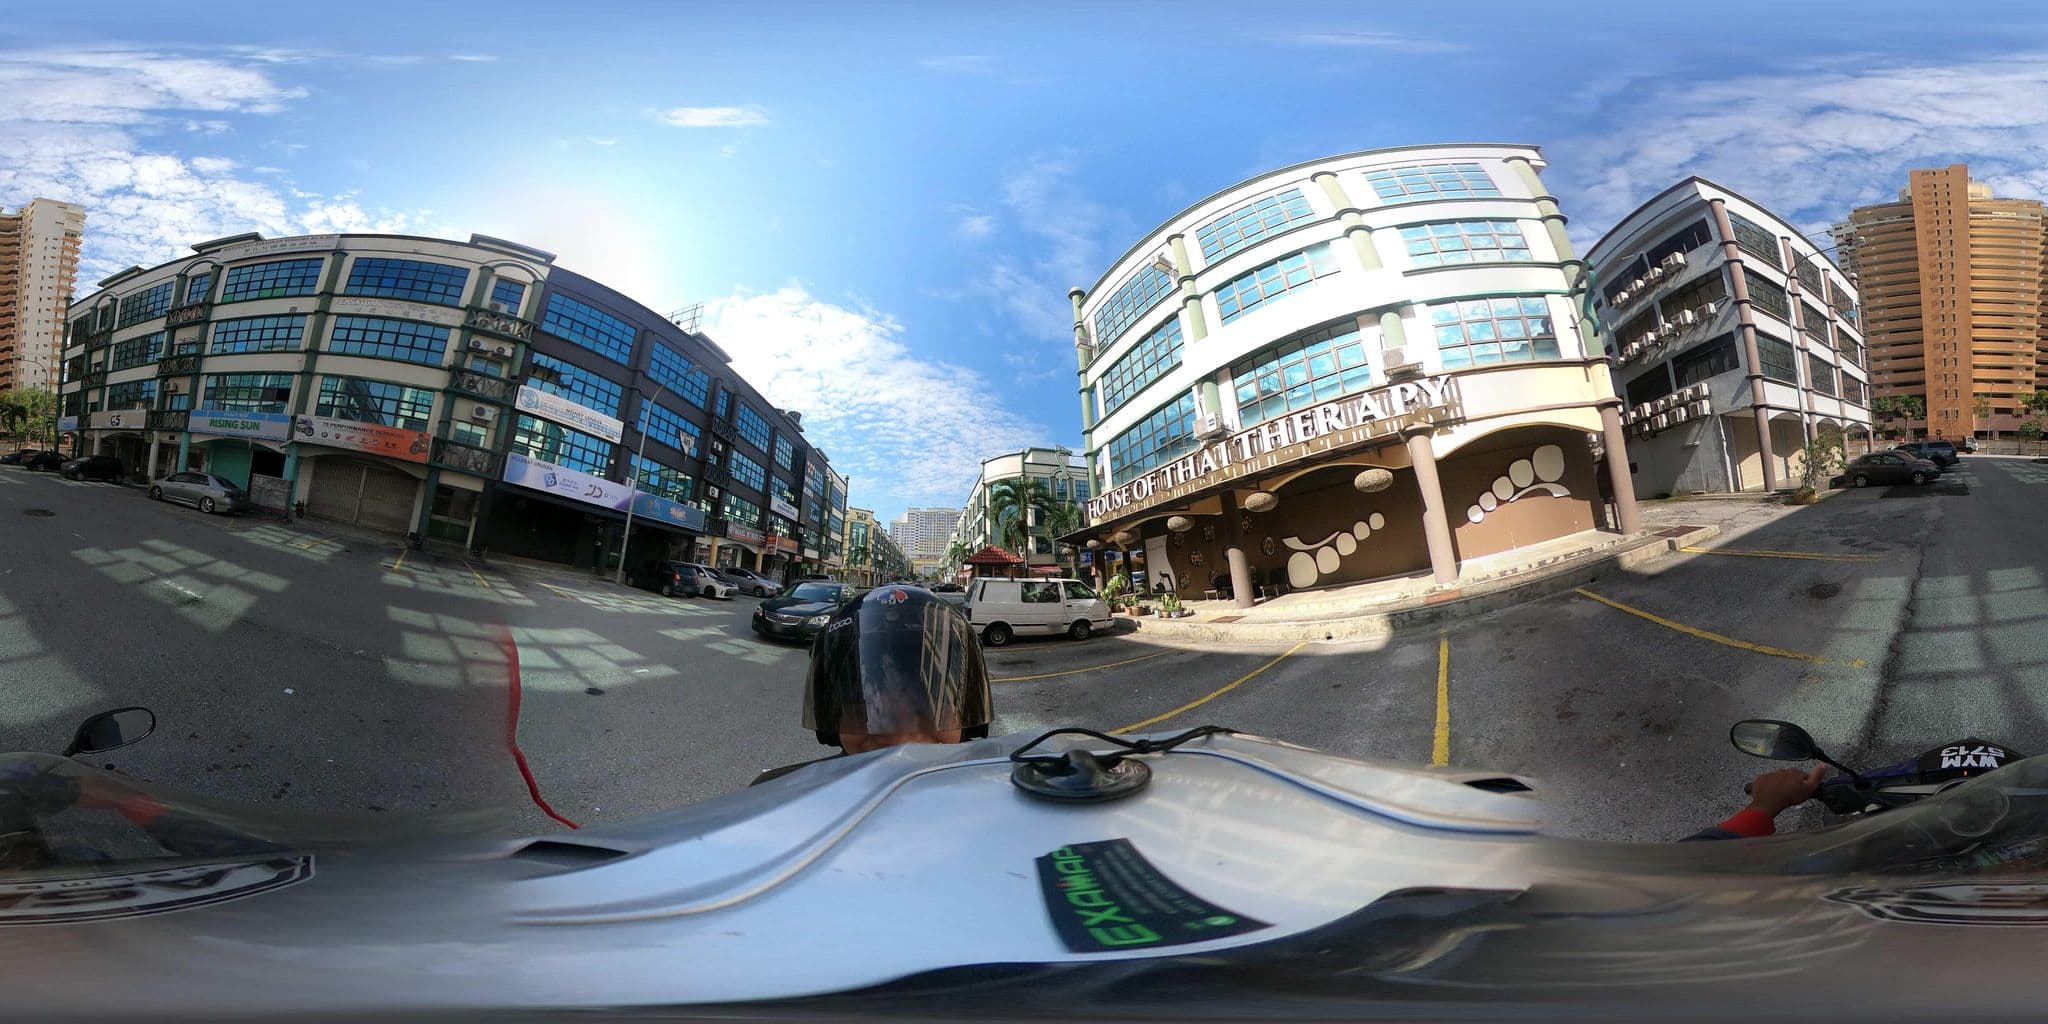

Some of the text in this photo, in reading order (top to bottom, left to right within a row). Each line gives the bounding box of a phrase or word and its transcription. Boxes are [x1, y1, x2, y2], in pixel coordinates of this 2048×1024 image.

[209, 418, 260, 431] RISING SUN
[1087, 375, 1451, 520] HOUSE OF THAI THERAPY
[1940, 745, 2005, 758] 5713
[1941, 755, 1999, 769] WYM
